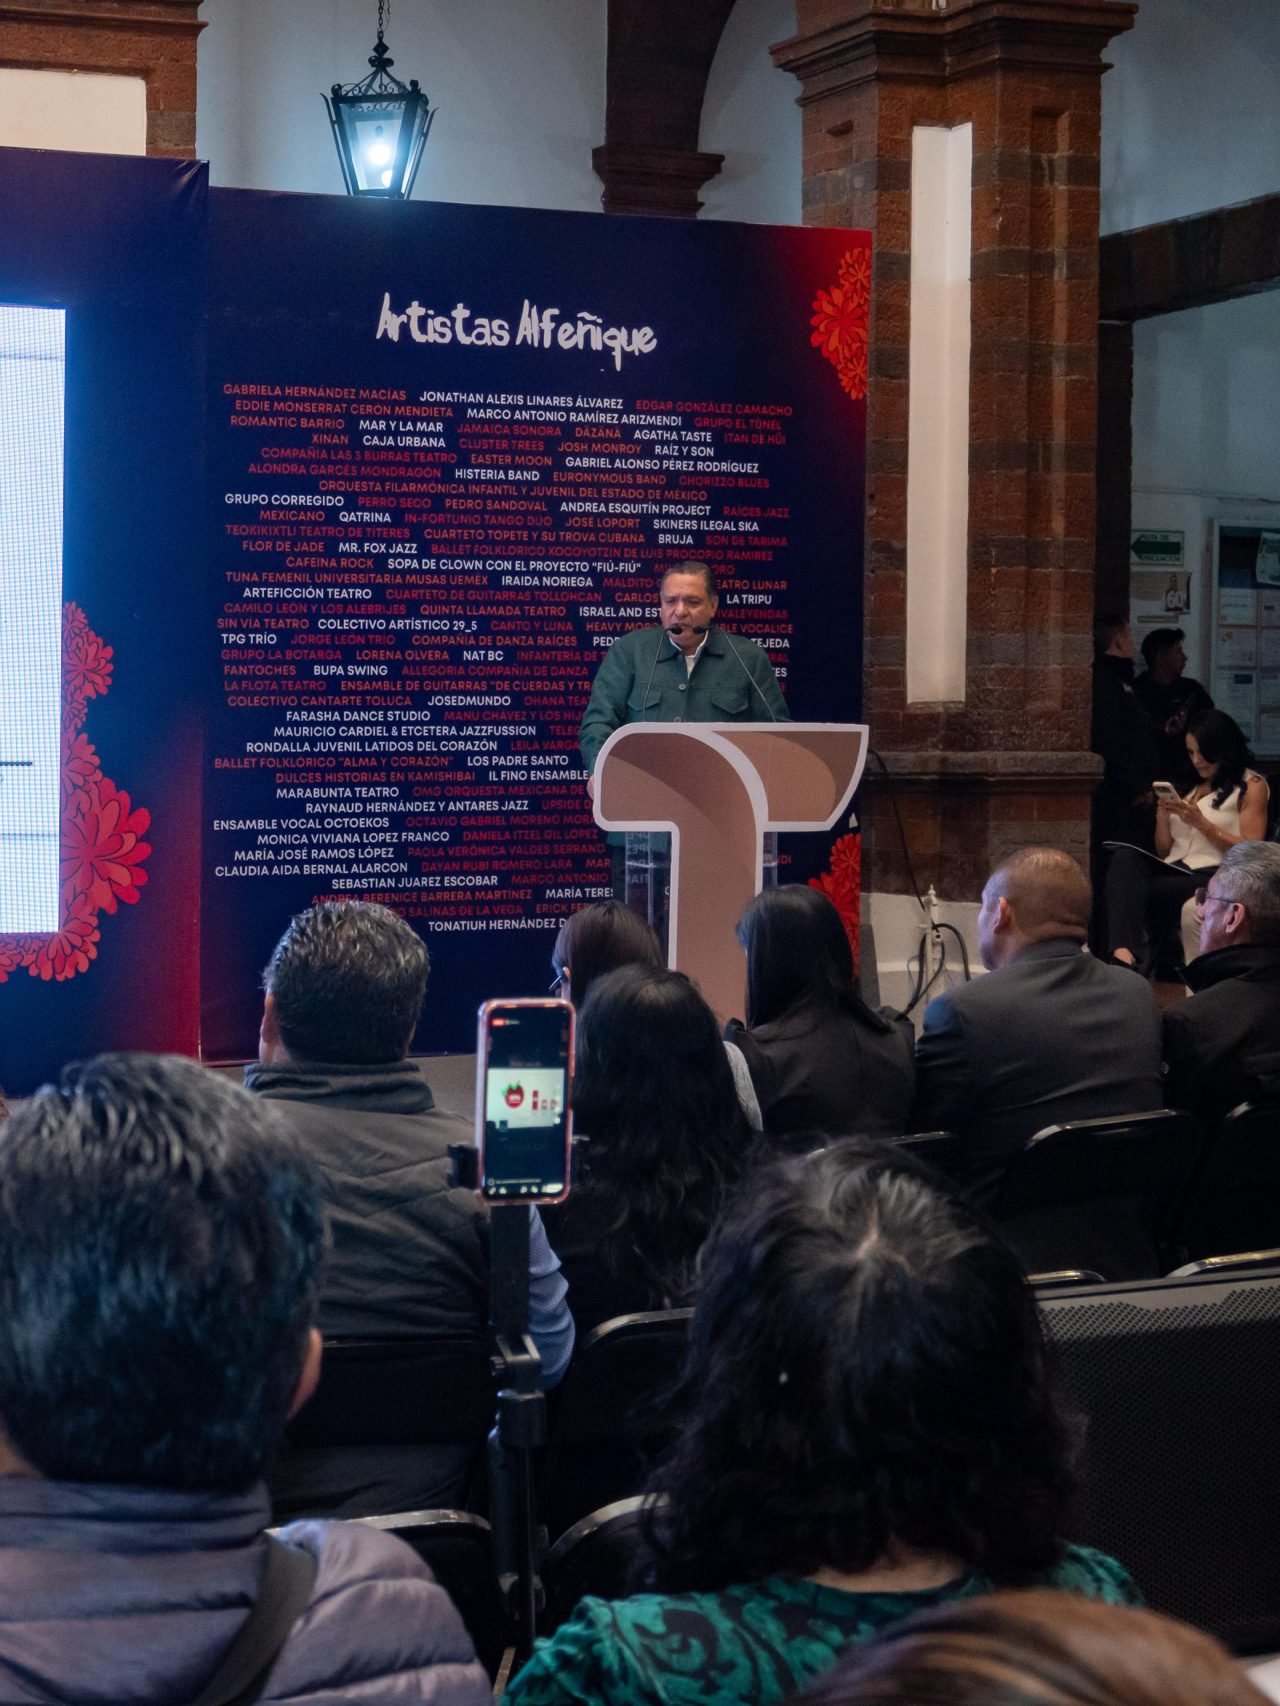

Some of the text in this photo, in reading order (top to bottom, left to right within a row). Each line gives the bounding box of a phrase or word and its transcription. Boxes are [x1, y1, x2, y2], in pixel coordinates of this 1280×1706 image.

[375, 292, 657, 372] Artistas Alfeñique
[419, 391, 483, 403] JONATHAN
[486, 393, 524, 405] ALEXIS
[526, 395, 573, 407] LINARES
[466, 408, 511, 420] MARCO
[513, 409, 567, 422] ANTONIO
[620, 414, 681, 426] ARIZMENDI
[359, 419, 443, 432] MAR Y LA MAR
[363, 435, 446, 447] CAJA URBANA
[633, 429, 712, 442] AGATHA TASTE
[681, 446, 688, 456] Y
[690, 446, 714, 457] SON
[565, 456, 612, 468] GABRIEL
[613, 458, 660, 470] ALONSO
[455, 468, 540, 481] HISTERIA BAND
[224, 493, 344, 506] GRUPO CORREGIDO
[560, 501, 606, 513] ANDREA
[662, 504, 711, 516] PROJECT
[339, 511, 391, 522] QATRINA
[653, 518, 759, 531] SKINERS ILEGAL SKA
[658, 533, 693, 544] BRUJA
[338, 542, 417, 554] MR. FOX JAZZ
[387, 558, 419, 569] SOPA
[421, 558, 436, 569] DE
[439, 559, 482, 570] CLOWN
[485, 560, 512, 570] CON
[515, 560, 527, 571] EL
[529, 560, 589, 572] PROYECTO
[501, 575, 593, 587] IRAIDA NORIEGA
[326, 588, 372, 599] TEATRO
[726, 594, 772, 605] LA TRIPU
[579, 606, 616, 617] ISRAEL
[618, 607, 642, 617] AND
[317, 618, 386, 629] COLECTIVO
[221, 633, 246, 644] TPG
[593, 636, 620, 647] PED
[463, 650, 503, 661] NAT BC
[313, 665, 388, 676] BUPA SWING
[427, 695, 511, 706] JOSEDMUNDO
[286, 710, 430, 721] FARASHA DANCE STUDIO
[273, 725, 536, 737] MAURICIO CARDIEL & ETCETERA JAZZFUSSION
[246, 741, 311, 753] RONDALLA
[312, 741, 362, 752] JUVENIL
[364, 741, 414, 751] LATIDOS
[416, 740, 437, 751] DEL
[467, 755, 568, 766] LOS PADRE SANTO
[489, 770, 589, 781] IL FINO ENSAMBLE
[276, 786, 399, 798] MARABUNTA TEATRO
[305, 802, 363, 813] RAYNAUD
[437, 801, 445, 811] Y
[447, 800, 499, 811] ANTARES
[501, 800, 529, 811] JAZZ
[213, 817, 389, 830] ENSAMBLE VOCAL OCTOEKOS
[257, 831, 449, 845] MONICA VIVIANA LOPEZ FRANCO
[311, 848, 355, 859] RAMOS
[214, 862, 408, 877] CLAUDIA AIDA BERNAL ALARCON
[331, 875, 498, 889] SEBASTIAN JUAREZ ESCOBAR
[428, 920, 486, 931] TONATIUH
